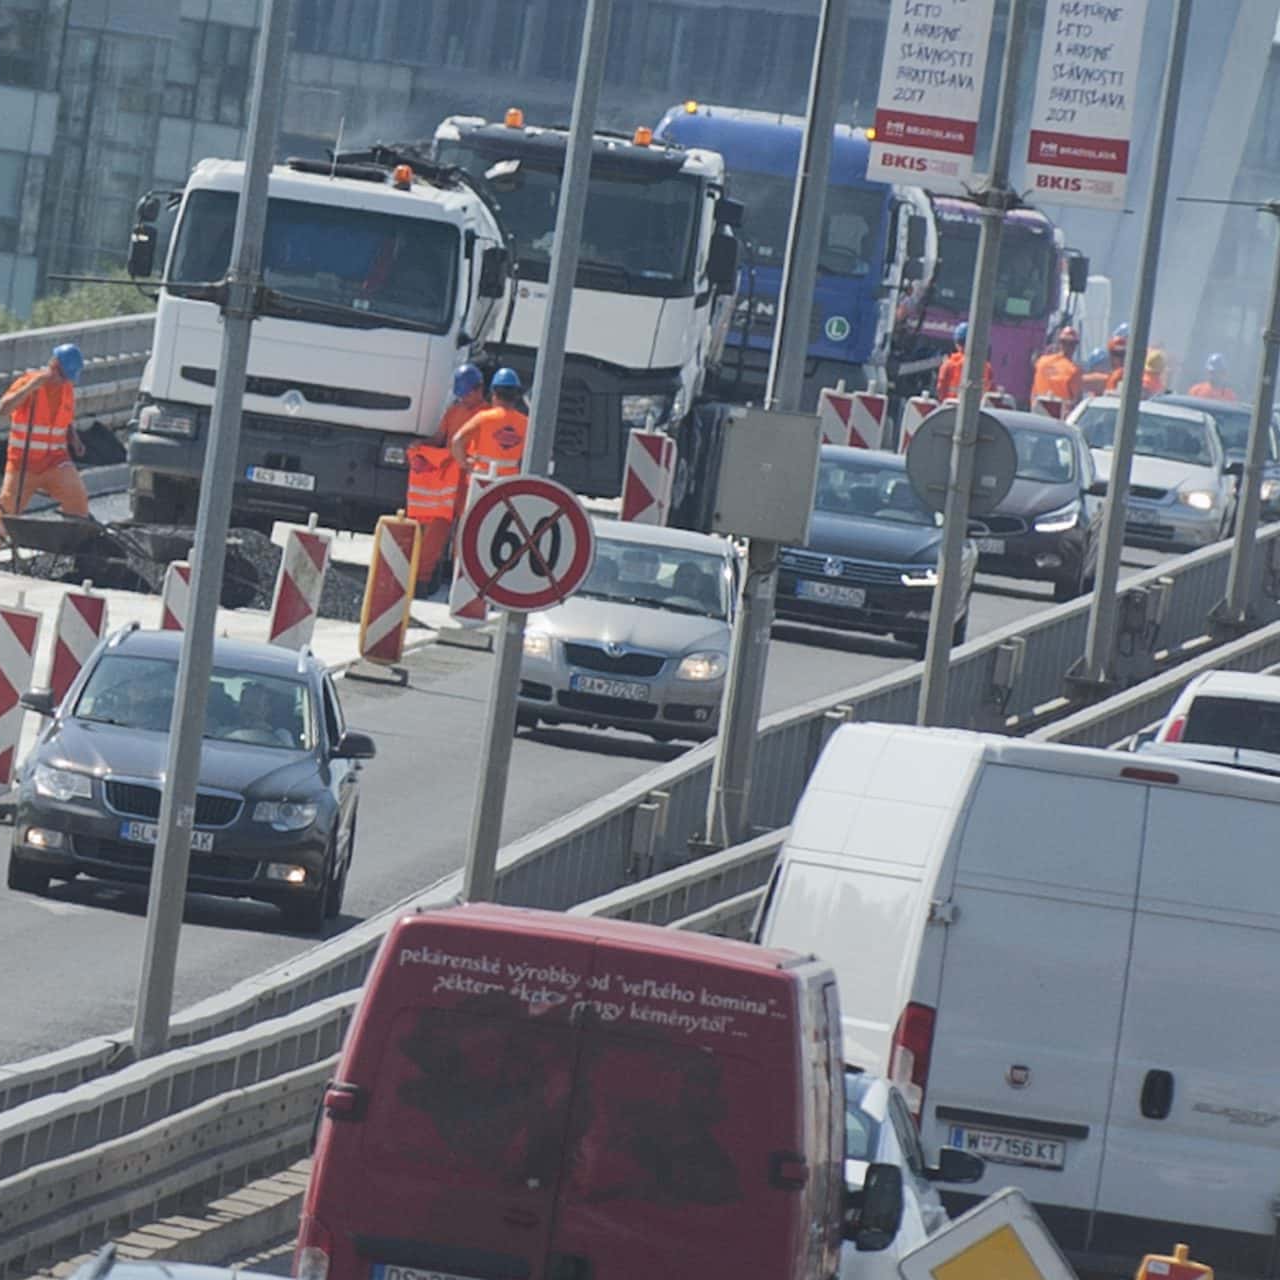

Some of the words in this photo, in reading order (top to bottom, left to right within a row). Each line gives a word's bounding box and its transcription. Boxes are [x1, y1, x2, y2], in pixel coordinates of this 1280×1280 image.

[880, 152, 928, 172] BKIS
[1036, 173, 1082, 192] BKIS
[490, 510, 561, 577] 60
[507, 962, 581, 989] výrobky
